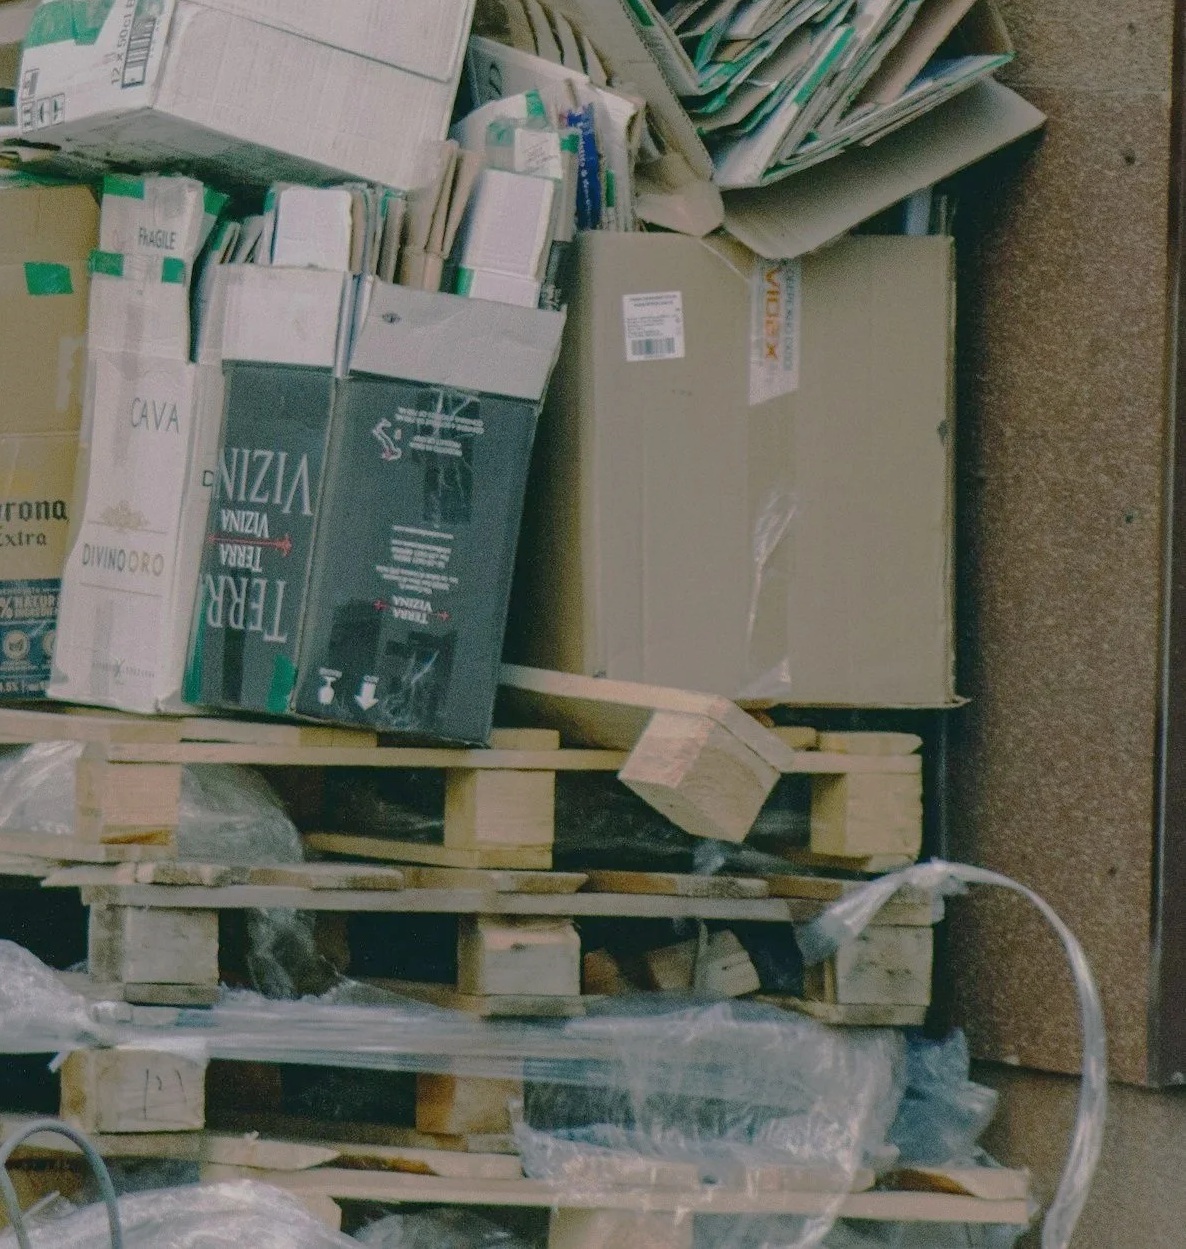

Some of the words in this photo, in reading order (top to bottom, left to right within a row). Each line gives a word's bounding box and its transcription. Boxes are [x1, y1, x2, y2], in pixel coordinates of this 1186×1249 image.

[111, 66, 121, 84] 12
[138, 227, 177, 250] FRAGILE
[131, 396, 180, 435] CAVA
[217, 448, 314, 517] VIZIN
[221, 509, 269, 538] VIZINA
[81, 543, 126, 573] DIVINO
[128, 552, 164, 578] ORO
[220, 543, 263, 573] TERRA
